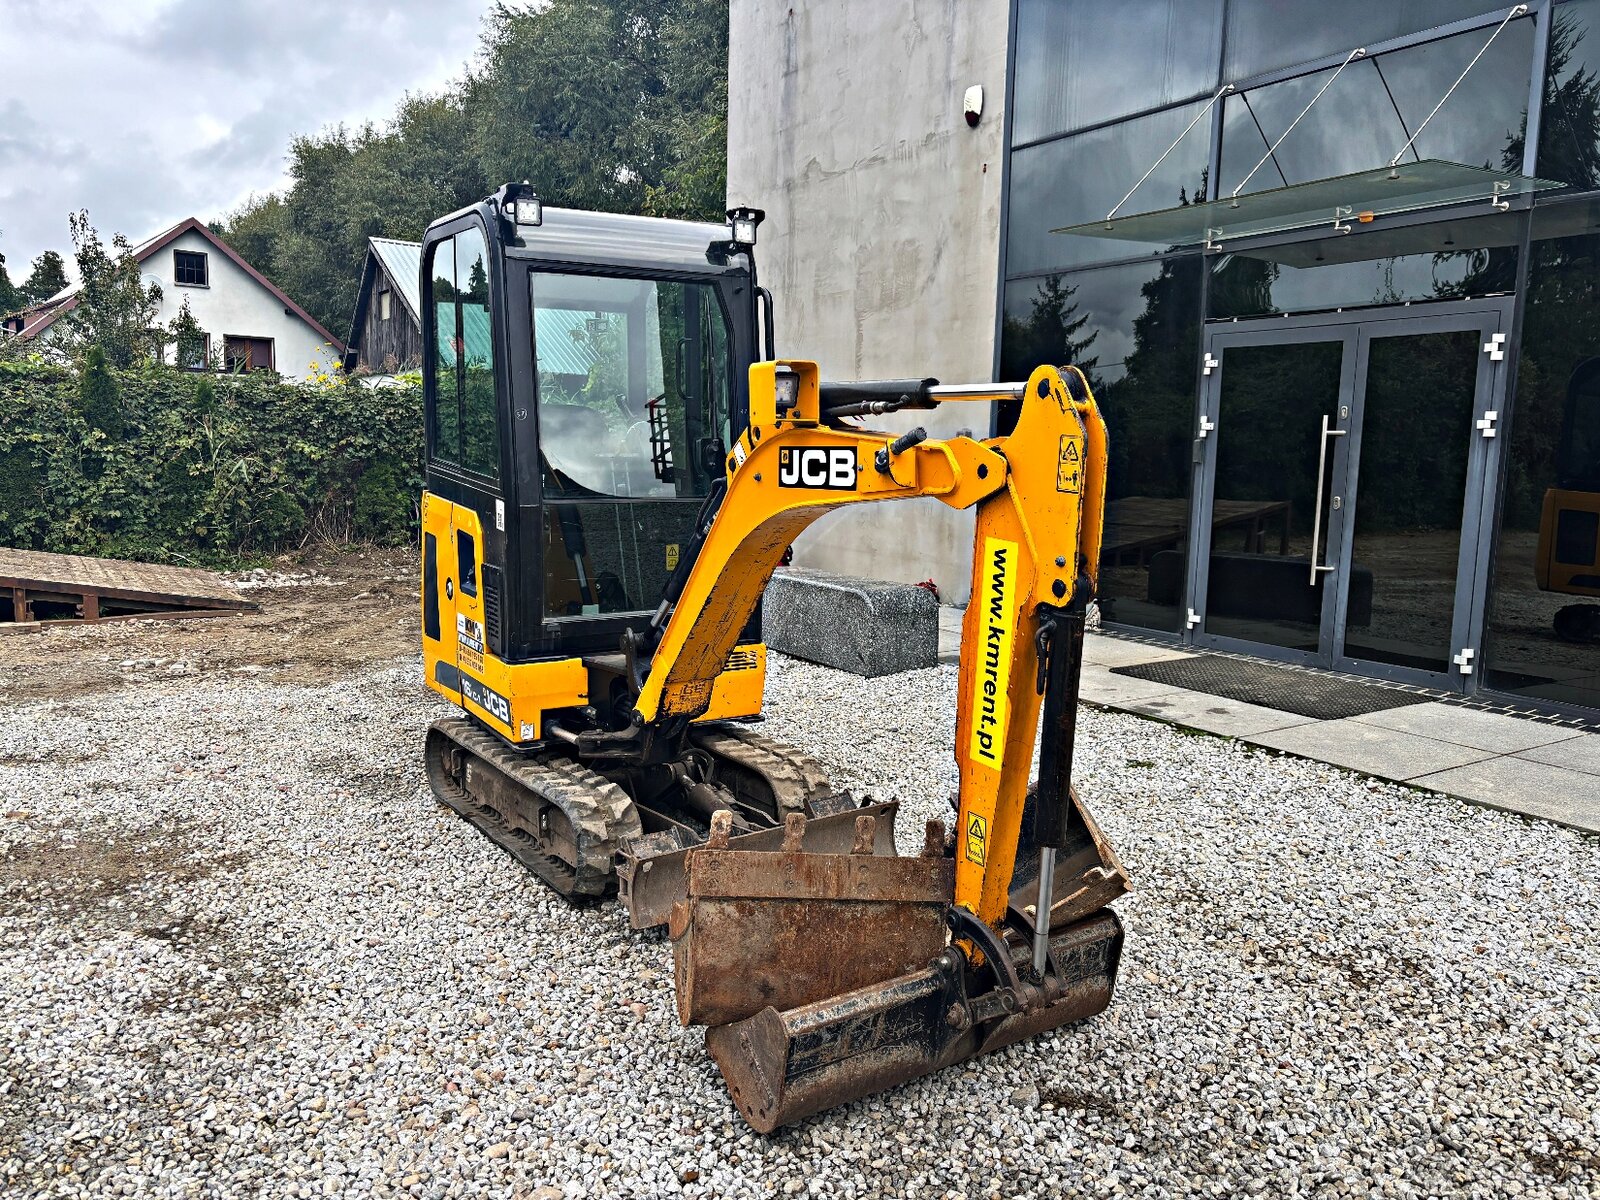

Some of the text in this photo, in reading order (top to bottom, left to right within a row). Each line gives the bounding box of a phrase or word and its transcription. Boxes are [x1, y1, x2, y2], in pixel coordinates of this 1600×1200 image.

[781, 449, 856, 487] JCB
[976, 548, 1007, 760] www.kmrent.pl
[483, 688, 509, 722] JCB
